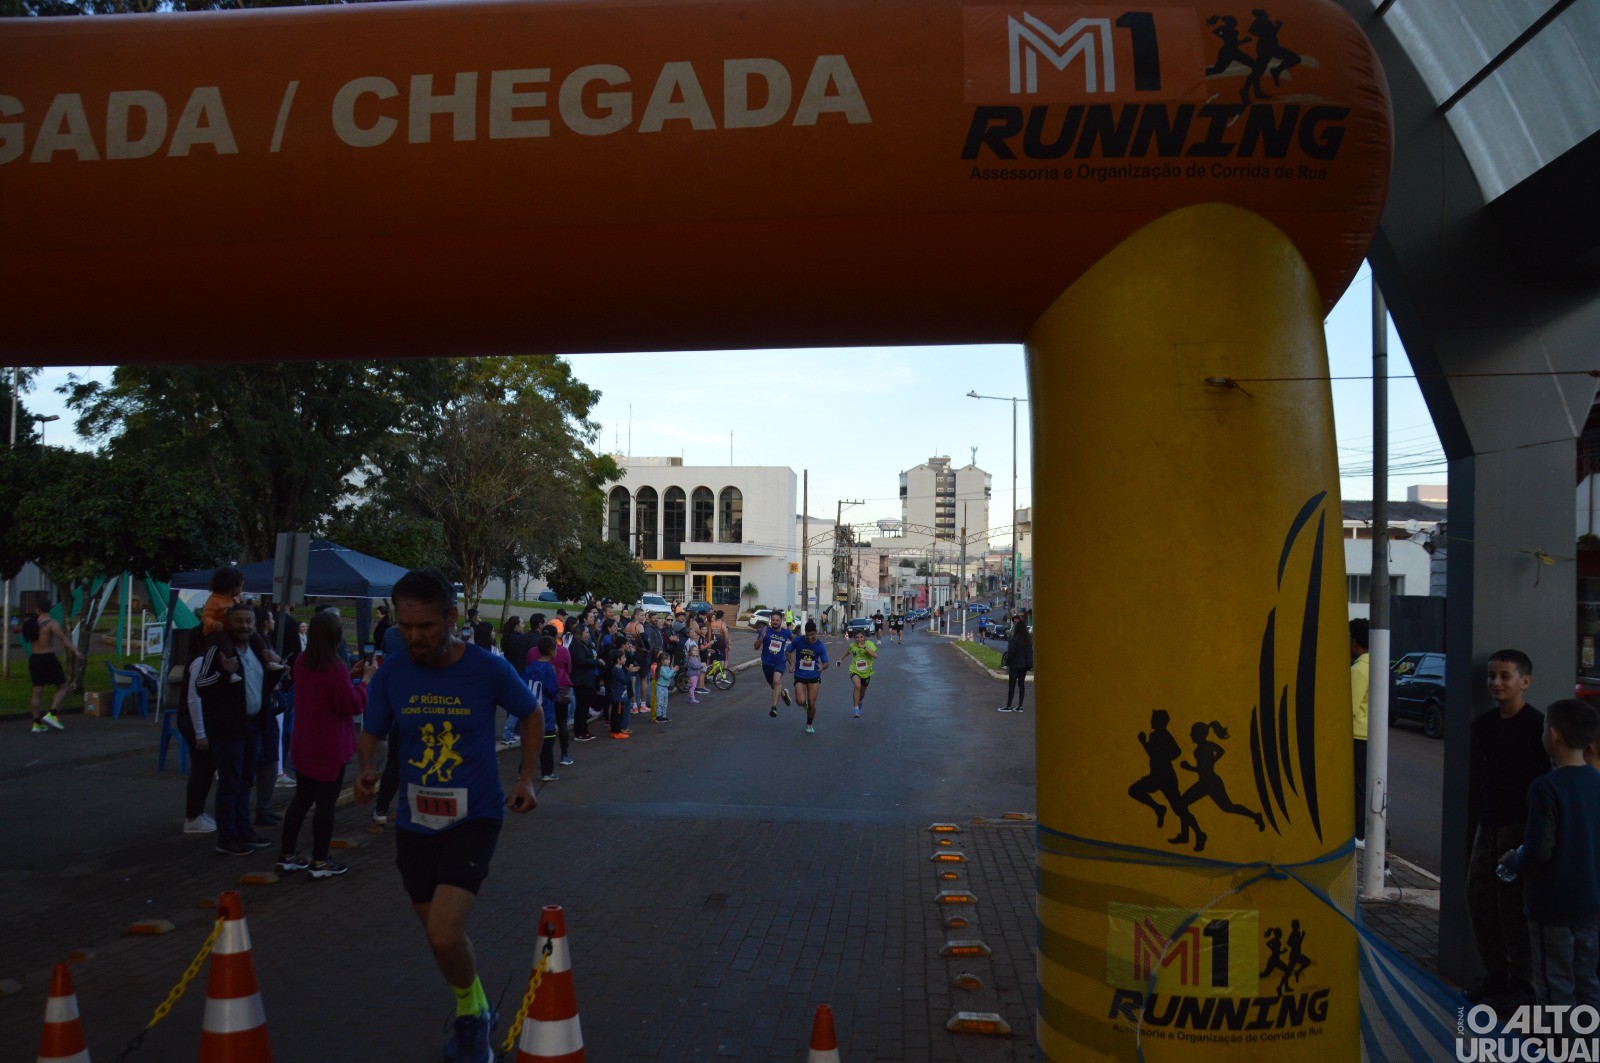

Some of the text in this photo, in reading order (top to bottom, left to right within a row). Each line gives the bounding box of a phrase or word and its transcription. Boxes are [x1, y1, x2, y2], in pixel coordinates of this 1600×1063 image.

[1007, 11, 1161, 95] M1
[270, 80, 299, 152] /
[331, 54, 872, 148] CHEGADA
[960, 103, 1351, 161] RUNNING
[969, 162, 1328, 184] Assessoria e Organização de Corrida de Rua
[421, 692, 462, 705] RÚSTICA
[422, 706, 446, 715] CLUBE
[422, 798, 451, 813] 111
[1108, 988, 1330, 1031] RUNNING
[1168, 1031, 1175, 1040] e
[1177, 1030, 1243, 1045] Organização
[1246, 1033, 1258, 1043] de
[1260, 1027, 1295, 1042] Corrida
[1297, 1029, 1307, 1039] de
[1309, 1021, 1323, 1037] Rua
